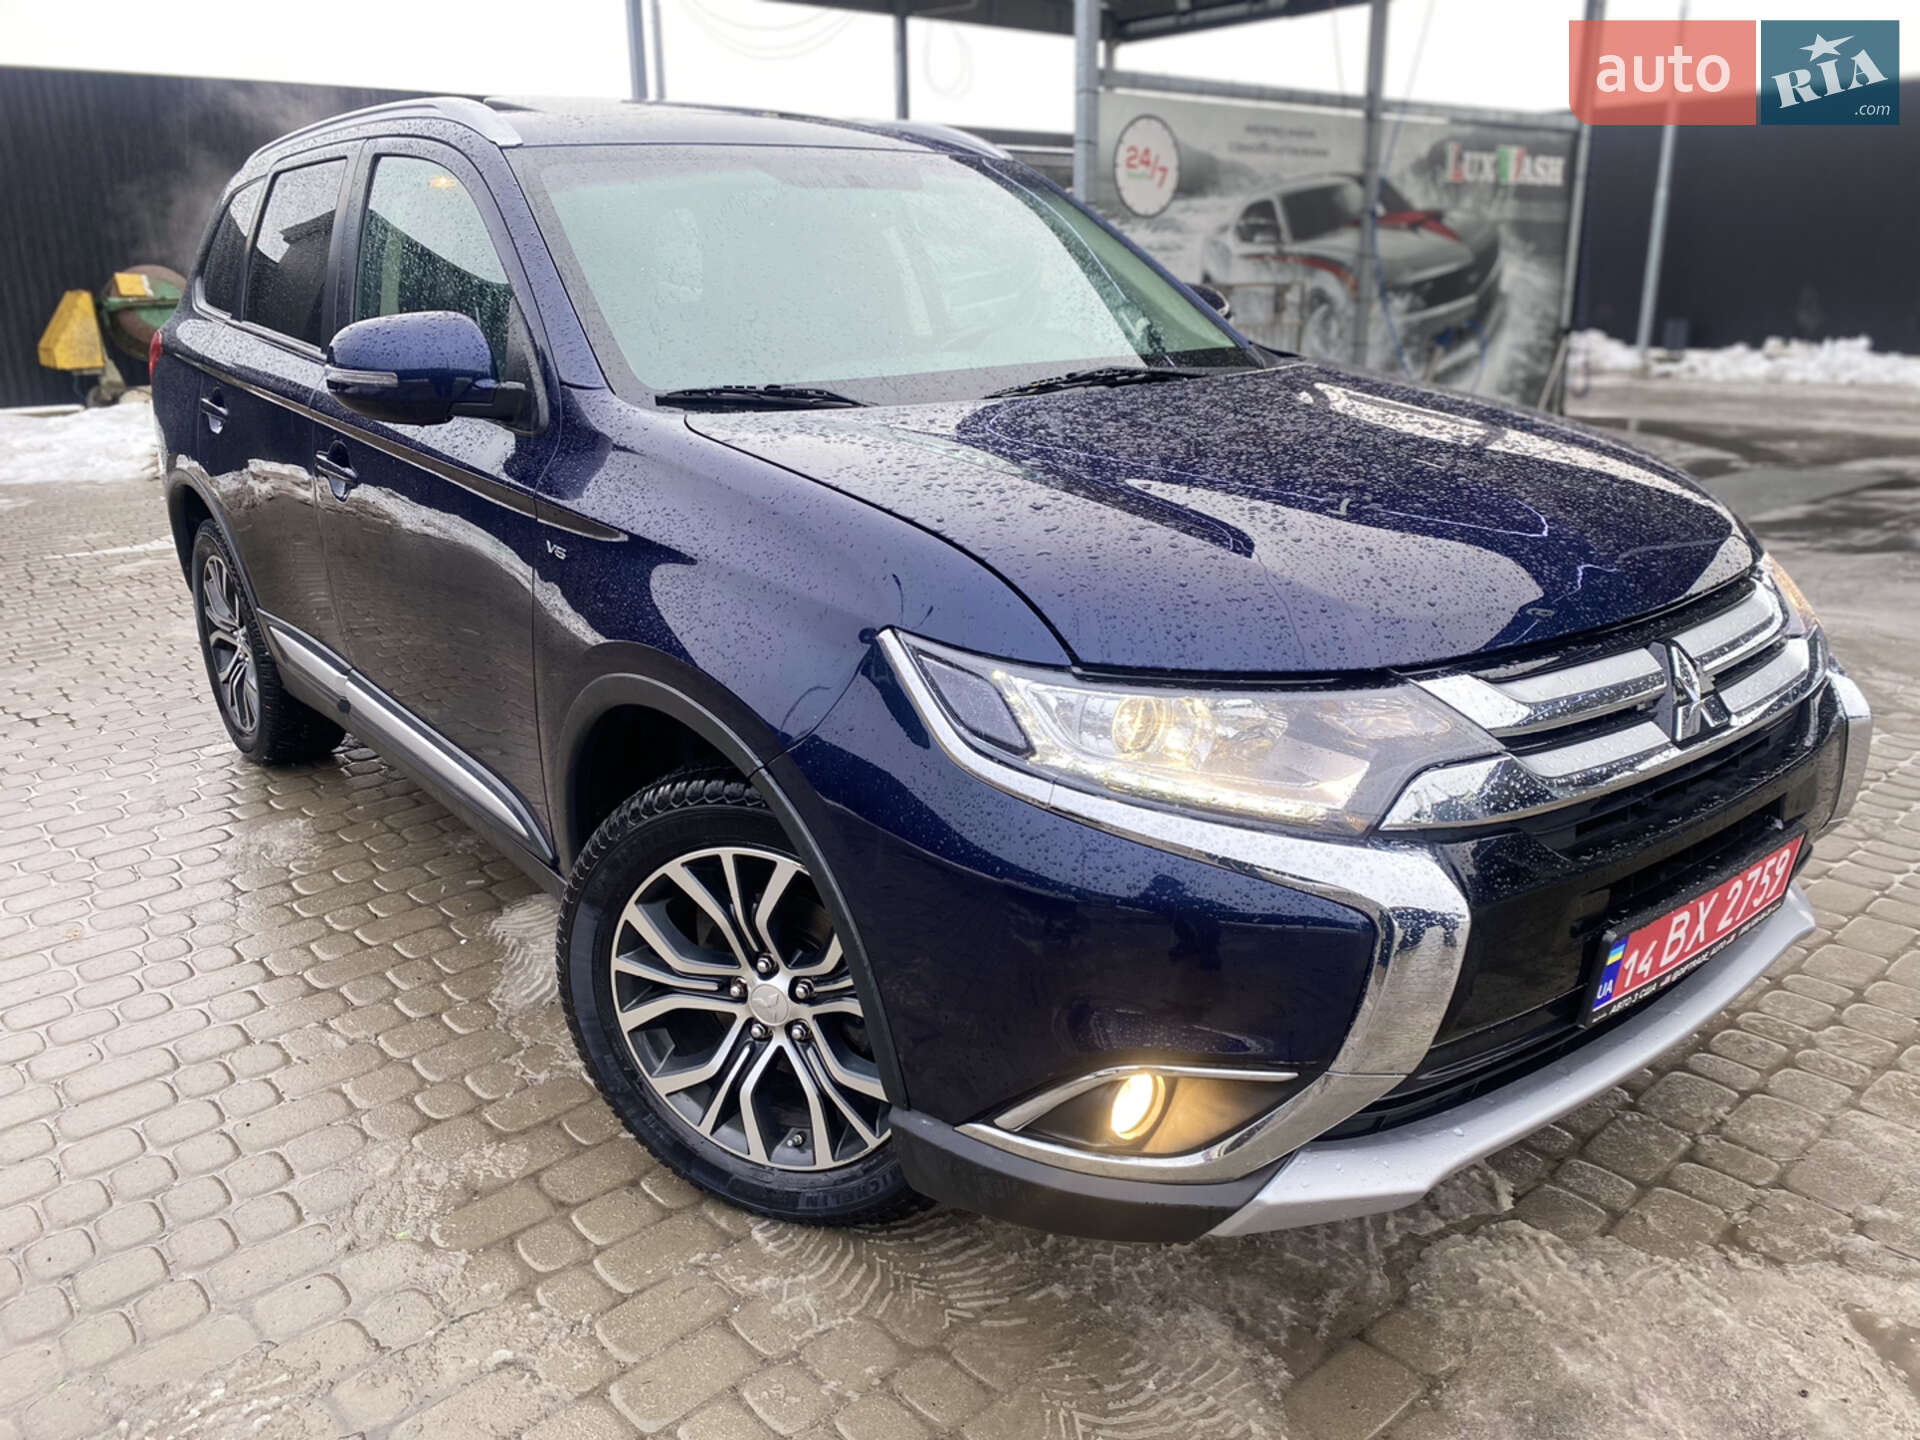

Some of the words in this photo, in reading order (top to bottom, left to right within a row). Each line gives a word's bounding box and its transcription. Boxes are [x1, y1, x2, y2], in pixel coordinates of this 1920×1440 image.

[1126, 146, 1168, 189] 24/7
[546, 539, 567, 560] V6
[1623, 940, 1657, 988] 14
[1660, 892, 1719, 968] BX
[1716, 848, 1791, 933] 2759
[1596, 979, 1614, 999] UA
